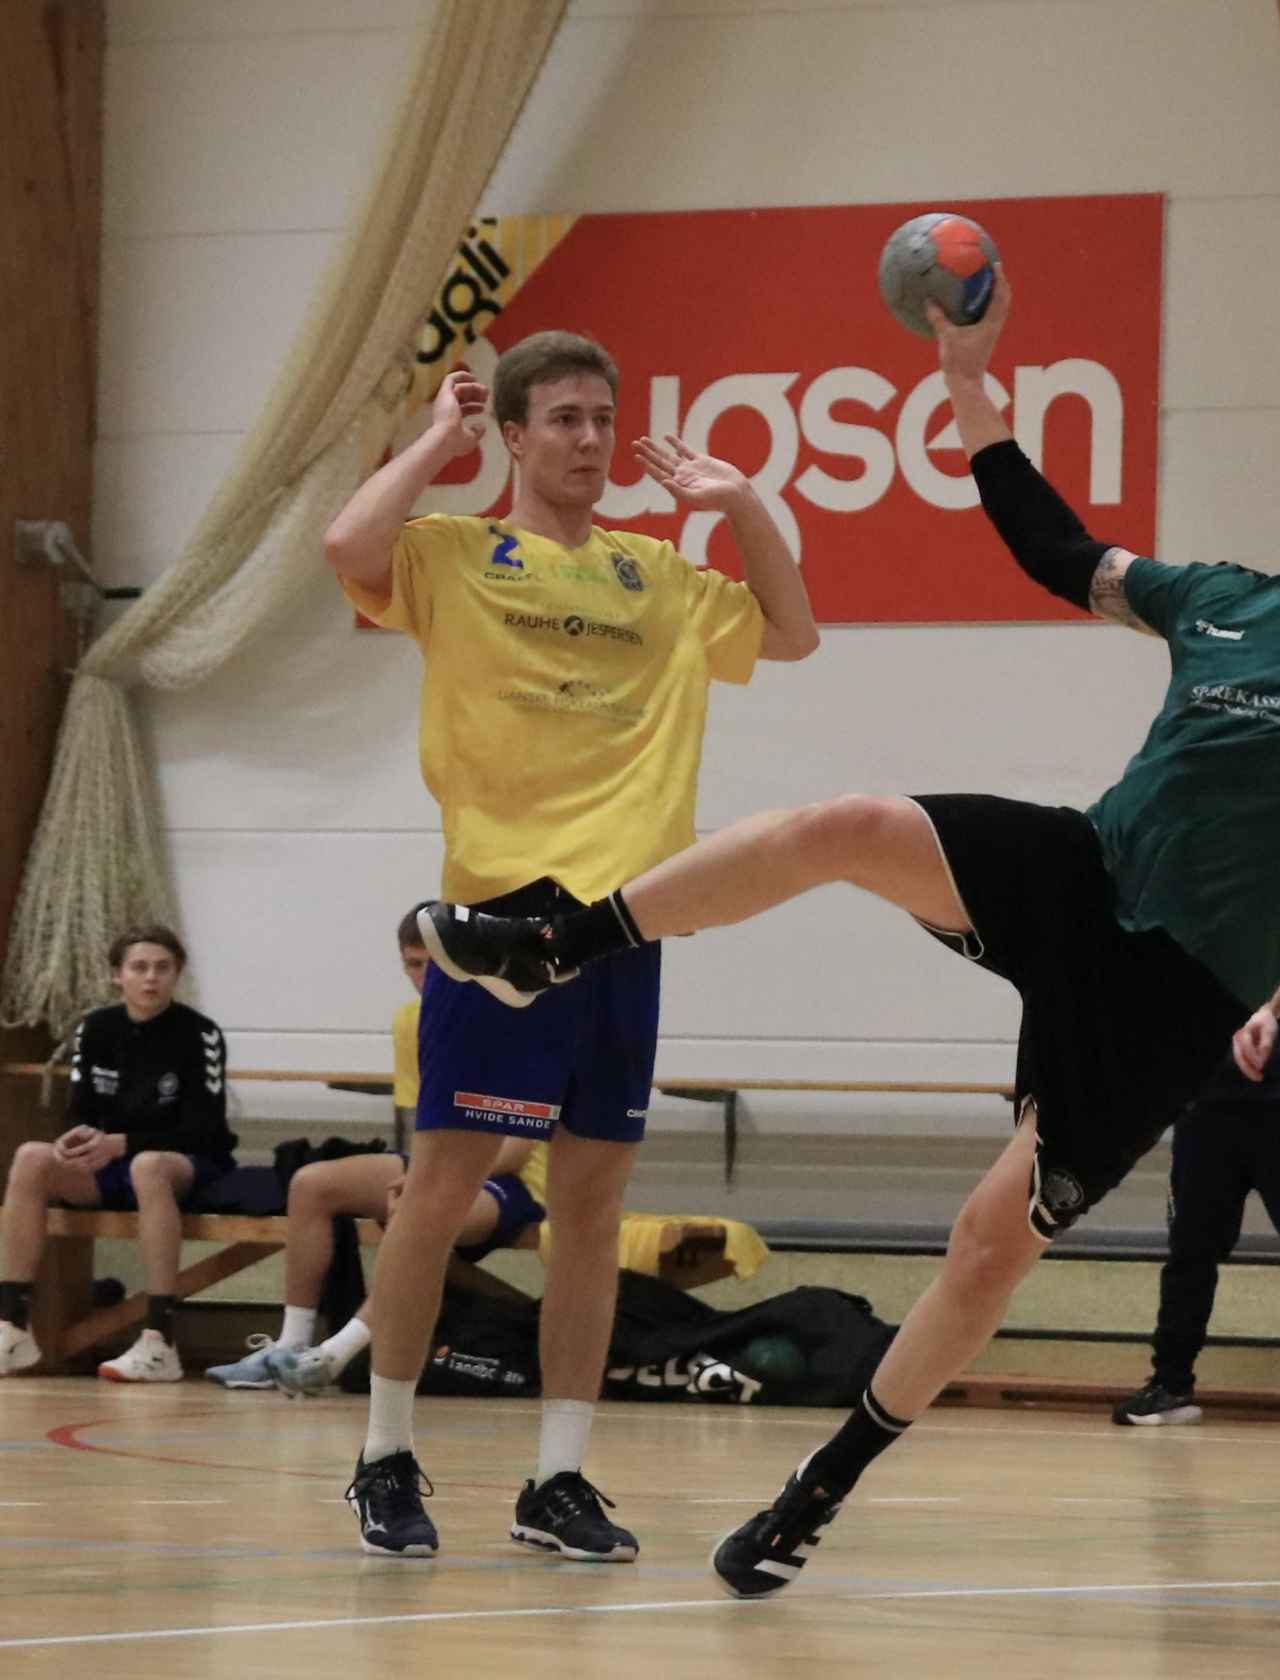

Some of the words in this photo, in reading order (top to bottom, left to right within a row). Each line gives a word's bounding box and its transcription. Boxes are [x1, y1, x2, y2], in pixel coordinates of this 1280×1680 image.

[489, 525, 524, 569] 2
[504, 613, 560, 631] RAUHE
[586, 622, 644, 646] JESPERSEN
[480, 1099, 525, 1113] SPAR
[464, 1110, 504, 1123] HVIDE
[508, 1116, 551, 1130] SANDE
